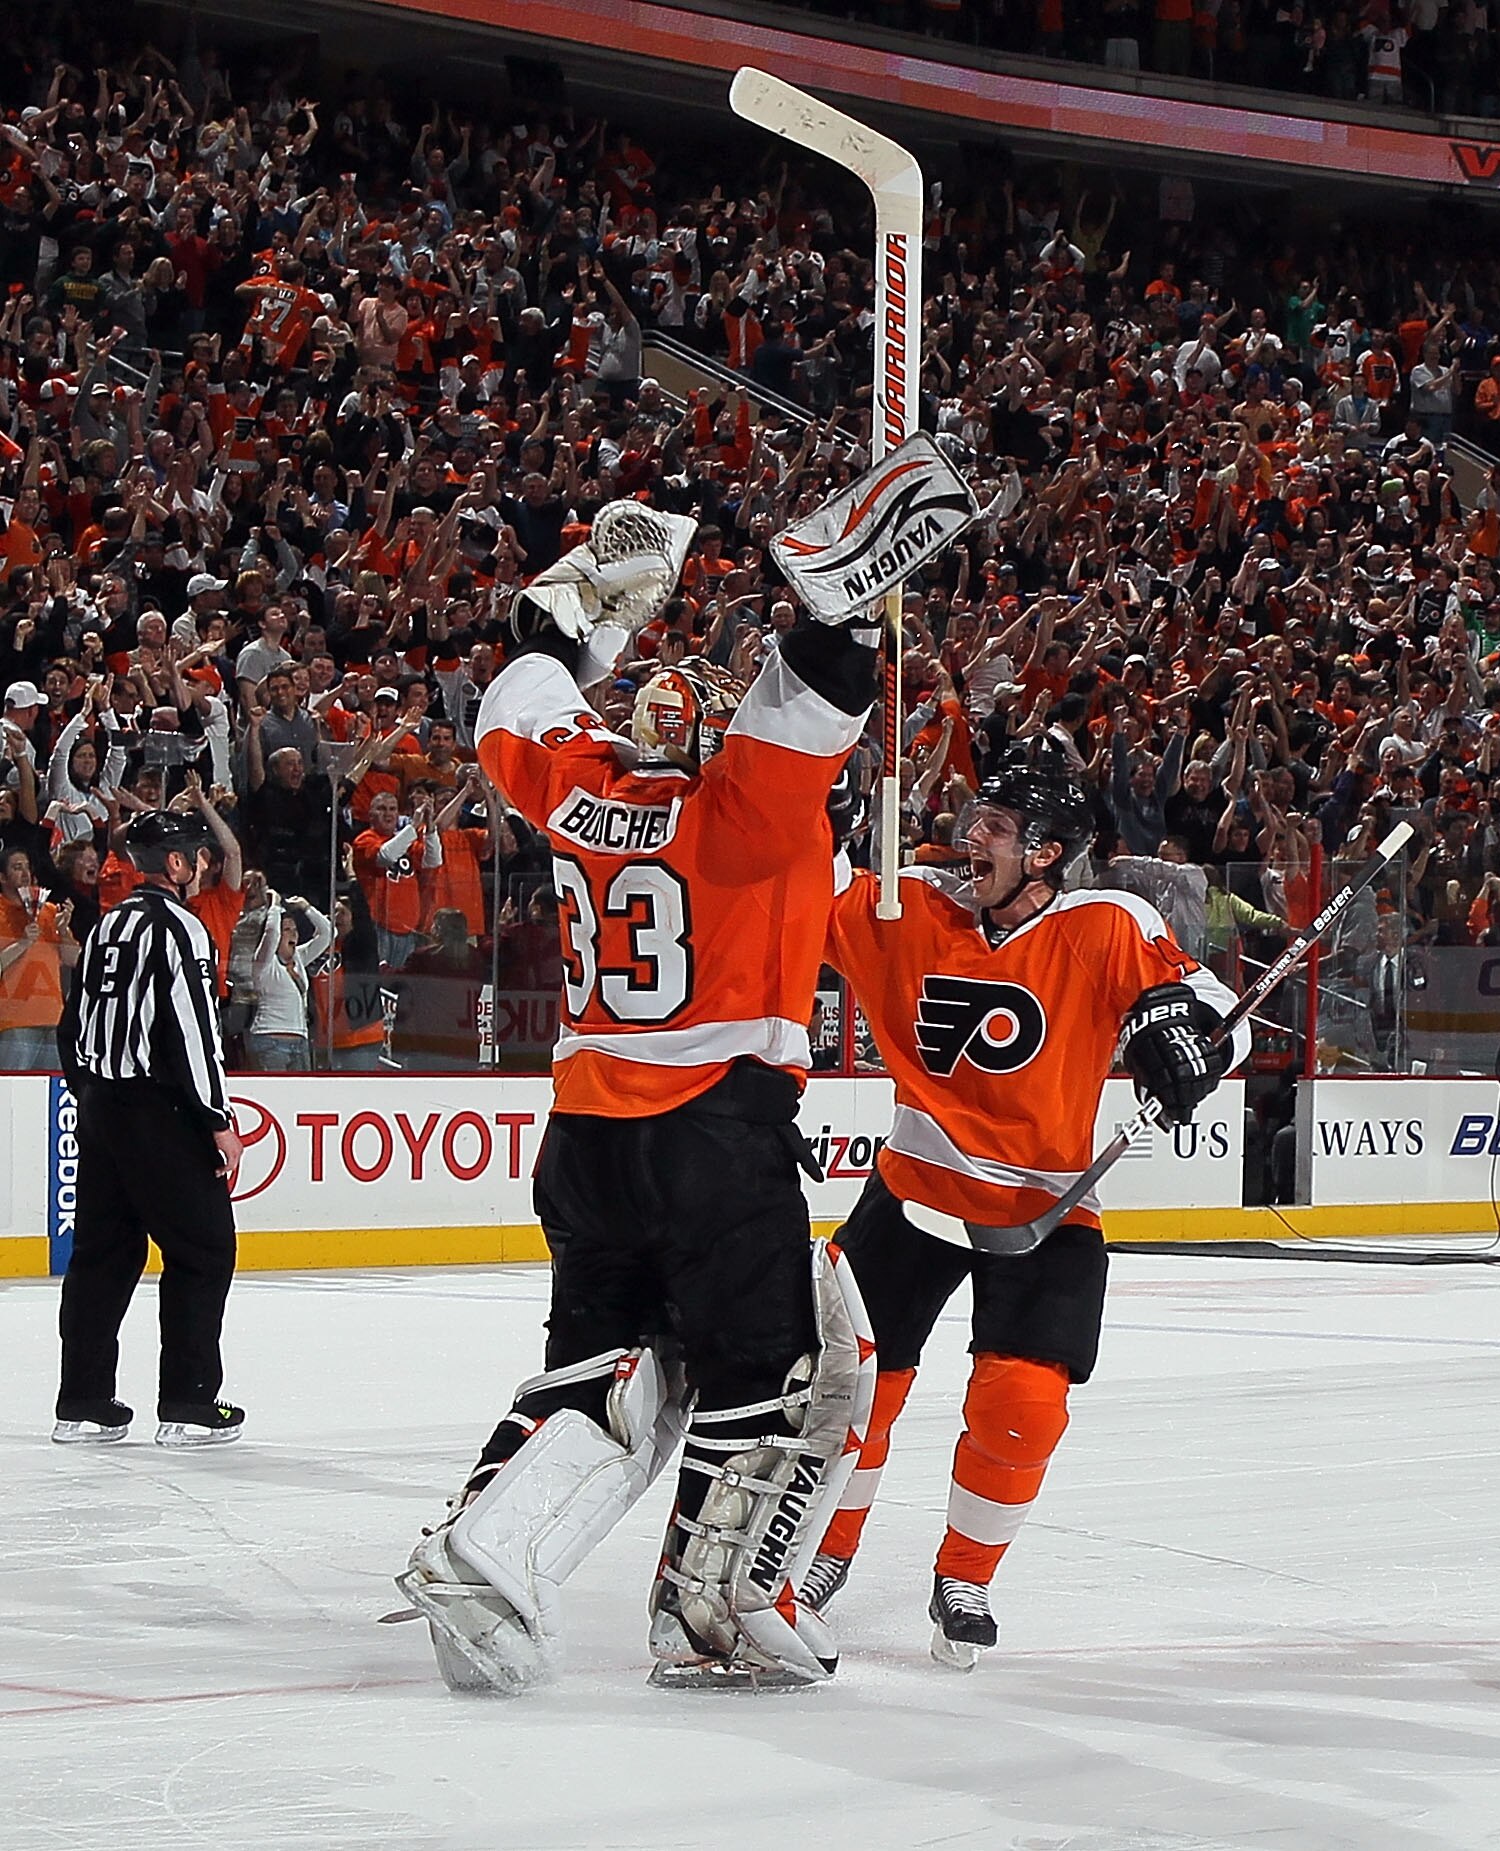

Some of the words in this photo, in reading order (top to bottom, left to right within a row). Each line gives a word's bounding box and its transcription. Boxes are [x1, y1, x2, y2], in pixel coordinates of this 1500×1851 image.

[842, 514, 944, 600] VAUGHN
[544, 850, 693, 1025] 33
[1115, 1002, 1190, 1063] AUER
[296, 1110, 552, 1182] TOYOT
[1313, 1120, 1424, 1156] WAYS
[748, 1453, 826, 1594] VAUGHN
